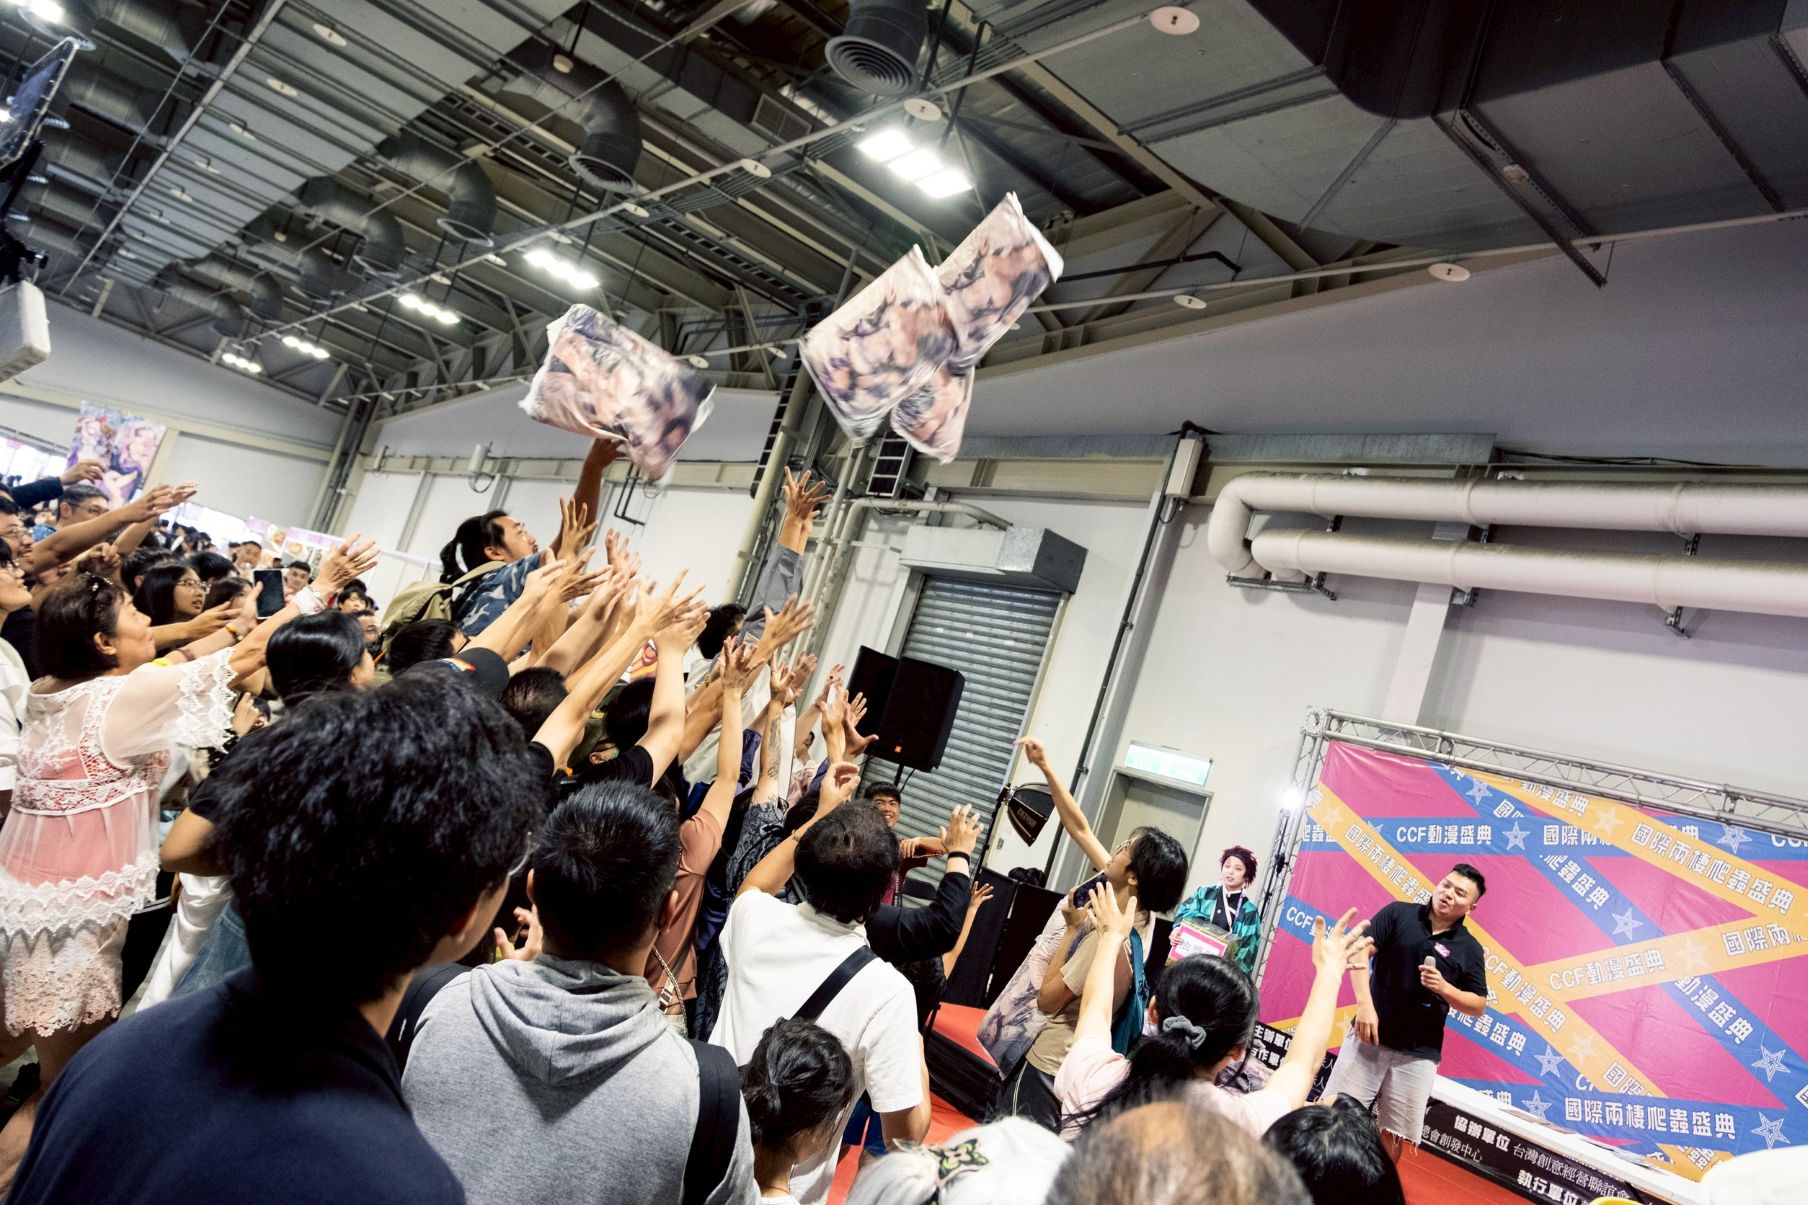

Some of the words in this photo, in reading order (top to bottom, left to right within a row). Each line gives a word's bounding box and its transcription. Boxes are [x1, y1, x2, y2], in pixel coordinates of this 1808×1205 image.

[1397, 825, 1492, 845] CCF動漫盛典
[1543, 825, 1612, 846] 國際兩
[1631, 823, 1794, 914] 國際兩棲爬蟲盛典
[1722, 923, 1806, 956] 國際兩
[1550, 949, 1664, 990] CCF動漫盛典
[1454, 1114, 1510, 1152] 協辦單位
[1565, 1097, 1736, 1139] 國際兩棲爬蟲盛典
